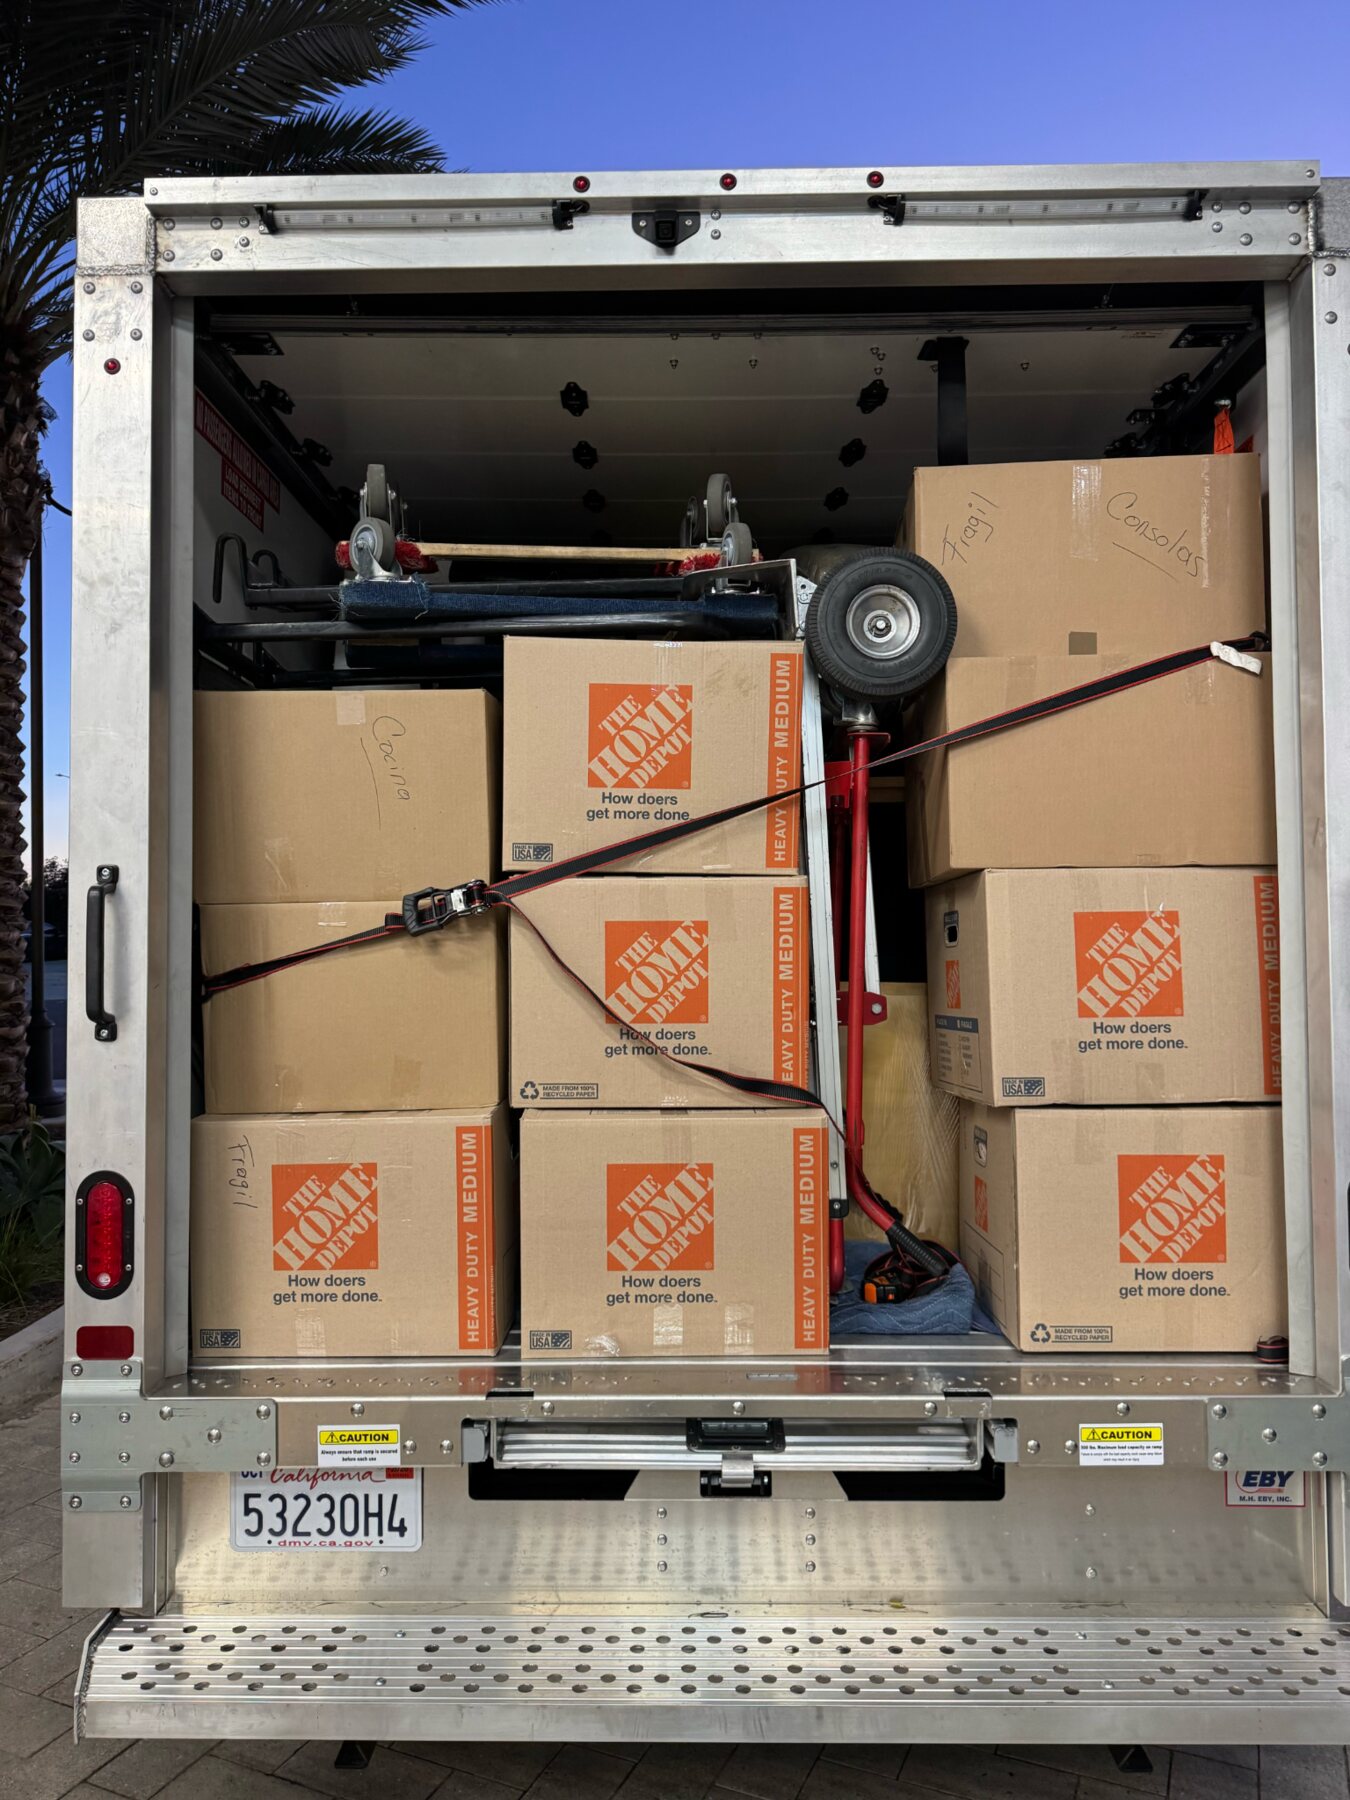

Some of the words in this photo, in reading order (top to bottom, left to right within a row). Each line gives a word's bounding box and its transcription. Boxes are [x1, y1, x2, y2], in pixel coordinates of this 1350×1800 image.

[1107, 491, 1204, 577] Consolas
[598, 694, 642, 736] THE
[774, 660, 791, 748] MEDIUM
[372, 715, 410, 800] Cocina
[588, 685, 694, 788] HOME
[628, 724, 692, 788] DEPOT
[602, 792, 633, 805] How
[637, 793, 678, 805] doers
[775, 756, 788, 799] UTY
[586, 808, 610, 821] get
[613, 810, 650, 820] more
[774, 807, 786, 861] HEAVY
[514, 849, 532, 860] USA
[779, 894, 794, 980] MEDIUM
[1085, 922, 1129, 965] THE
[1260, 882, 1279, 970] MEDIUM
[606, 920, 709, 1023] HOME
[614, 931, 659, 973] THE
[1078, 911, 1181, 1018] HOME
[646, 958, 709, 1023] DEPOT
[1120, 949, 1182, 1018] DEPOT
[1268, 979, 1281, 1024] DUTY
[782, 988, 793, 1033] DUTY
[1093, 1022, 1125, 1034] How
[1130, 1021, 1171, 1034] doers
[605, 1044, 628, 1058] get
[632, 1045, 668, 1055] more
[620, 1028, 651, 1040] How
[655, 1028, 696, 1040] doers
[1078, 1039, 1102, 1053] get
[1106, 1040, 1144, 1050] more
[781, 1039, 794, 1083] EAVY
[1005, 1084, 1023, 1094] USA
[282, 1175, 326, 1217] THE
[462, 1133, 478, 1223] MEDIUM
[617, 1174, 662, 1218] THE
[799, 1135, 815, 1225] MEDIUM
[1129, 1165, 1173, 1209] THE
[273, 1163, 378, 1270] HOME
[607, 1163, 714, 1271] HOME
[1119, 1154, 1225, 1263] HOME
[1162, 1194, 1225, 1263] DEPOT
[315, 1202, 378, 1270] DEPOT
[466, 1232, 478, 1277] DUTY
[648, 1203, 714, 1271] DEPOT
[803, 1233, 815, 1278] DUTY
[288, 1274, 320, 1287] How
[324, 1274, 366, 1286] doers
[622, 1275, 655, 1287] How
[659, 1275, 701, 1287] doers
[1119, 1285, 1143, 1299] get
[1148, 1286, 1185, 1296] more
[1134, 1268, 1167, 1280] How
[1172, 1268, 1214, 1280] doers
[273, 1291, 297, 1305] get
[301, 1292, 338, 1302] more
[466, 1285, 479, 1342] HEAVY
[606, 1292, 630, 1306] get
[634, 1293, 672, 1303] more
[803, 1286, 815, 1342] HEAVY
[202, 1335, 220, 1346] USA
[532, 1337, 550, 1347] USA
[339, 1434, 389, 1442] CAUTION
[1101, 1431, 1152, 1439] CAUTION
[270, 1468, 386, 1490] California
[1243, 1471, 1295, 1487] EBY
[243, 1493, 407, 1538] 53230H4
[278, 1539, 374, 1547] dmv.ca.gov
